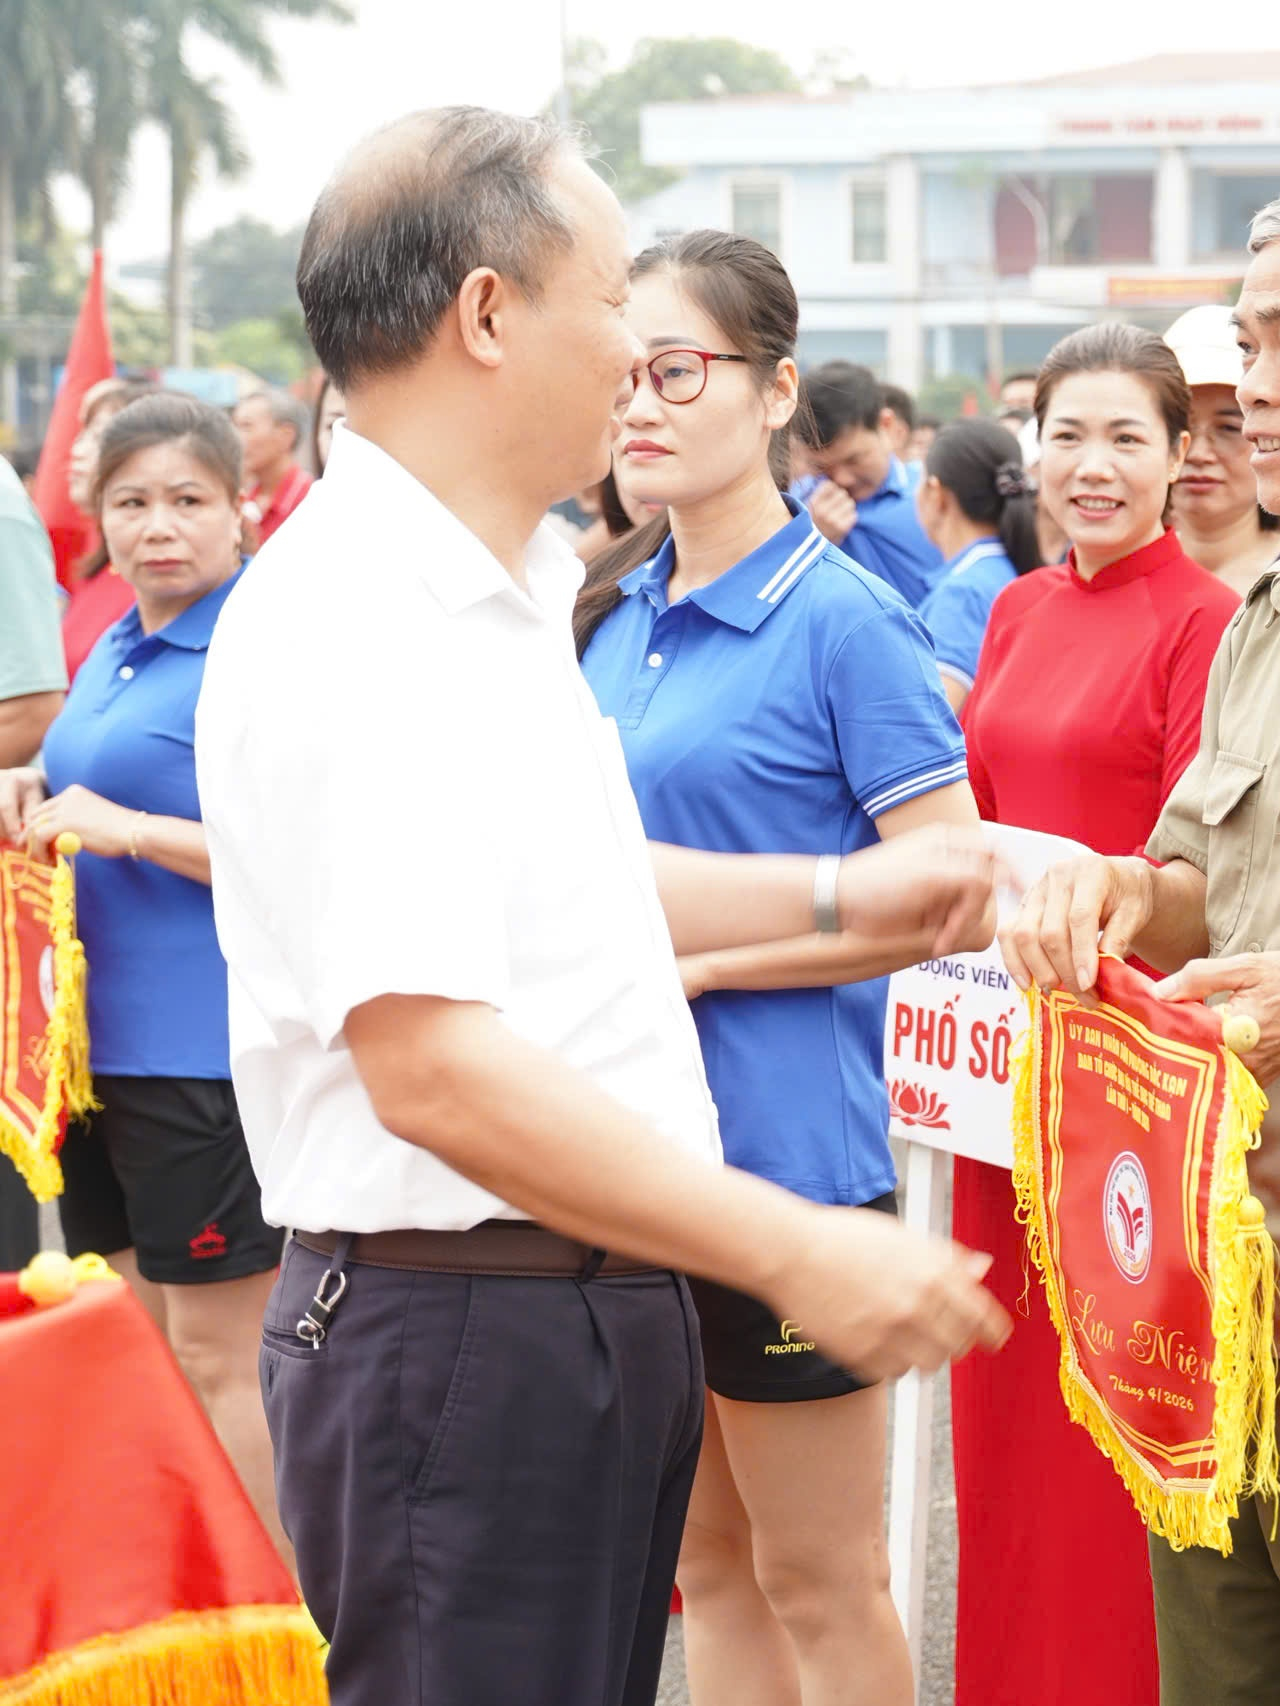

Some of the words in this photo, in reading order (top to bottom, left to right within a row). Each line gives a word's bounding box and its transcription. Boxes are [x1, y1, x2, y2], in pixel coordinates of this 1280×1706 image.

[971, 966, 1009, 990] VIÊN
[893, 994, 961, 1071] PHỐ
[968, 1007, 1016, 1085] SỐ
[1072, 1289, 1116, 1356] Lưu
[1108, 1374, 1145, 1401] Tháng
